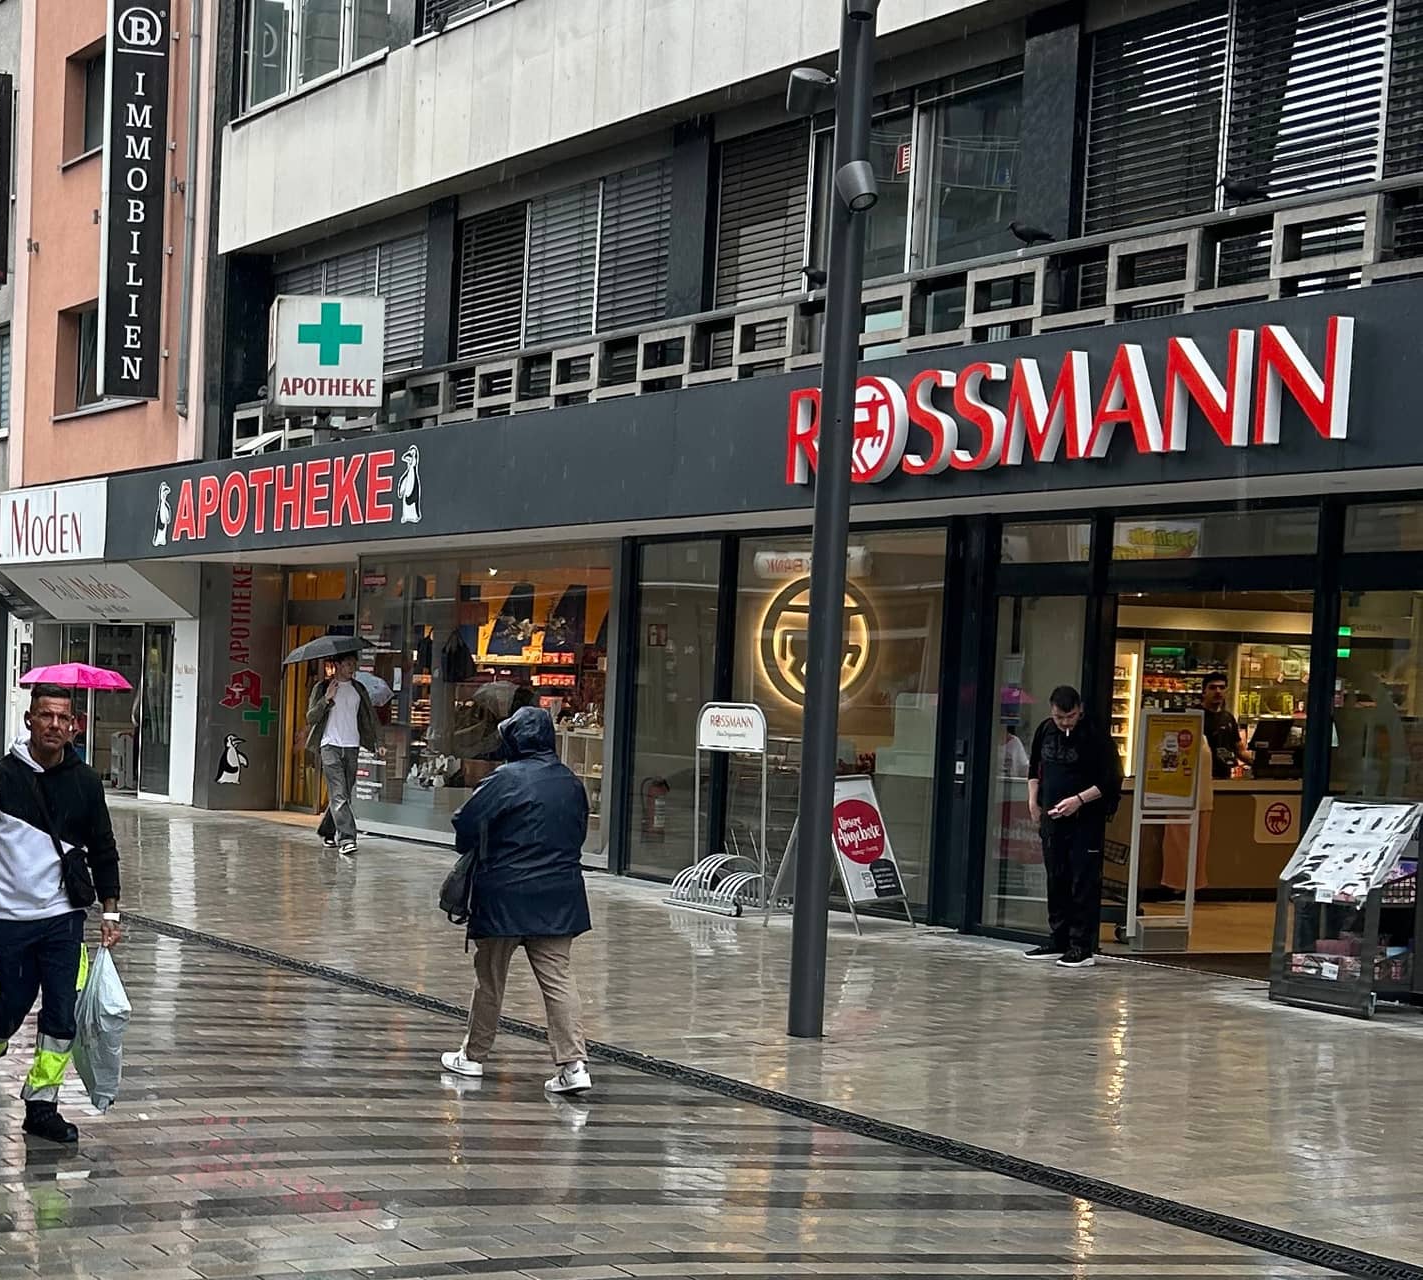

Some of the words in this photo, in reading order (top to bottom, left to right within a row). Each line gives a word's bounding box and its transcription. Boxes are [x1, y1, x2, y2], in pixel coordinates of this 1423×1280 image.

[121, 72, 153, 381] IMMOBILIEN
[279, 377, 377, 398] APOTHEKE
[172, 448, 396, 541] APOTHEKE
[230, 565, 254, 665] APOTHEKE
[710, 715, 753, 728] ROSSMANN
[838, 816, 862, 829] Unsere
[838, 823, 882, 848] Angebote
